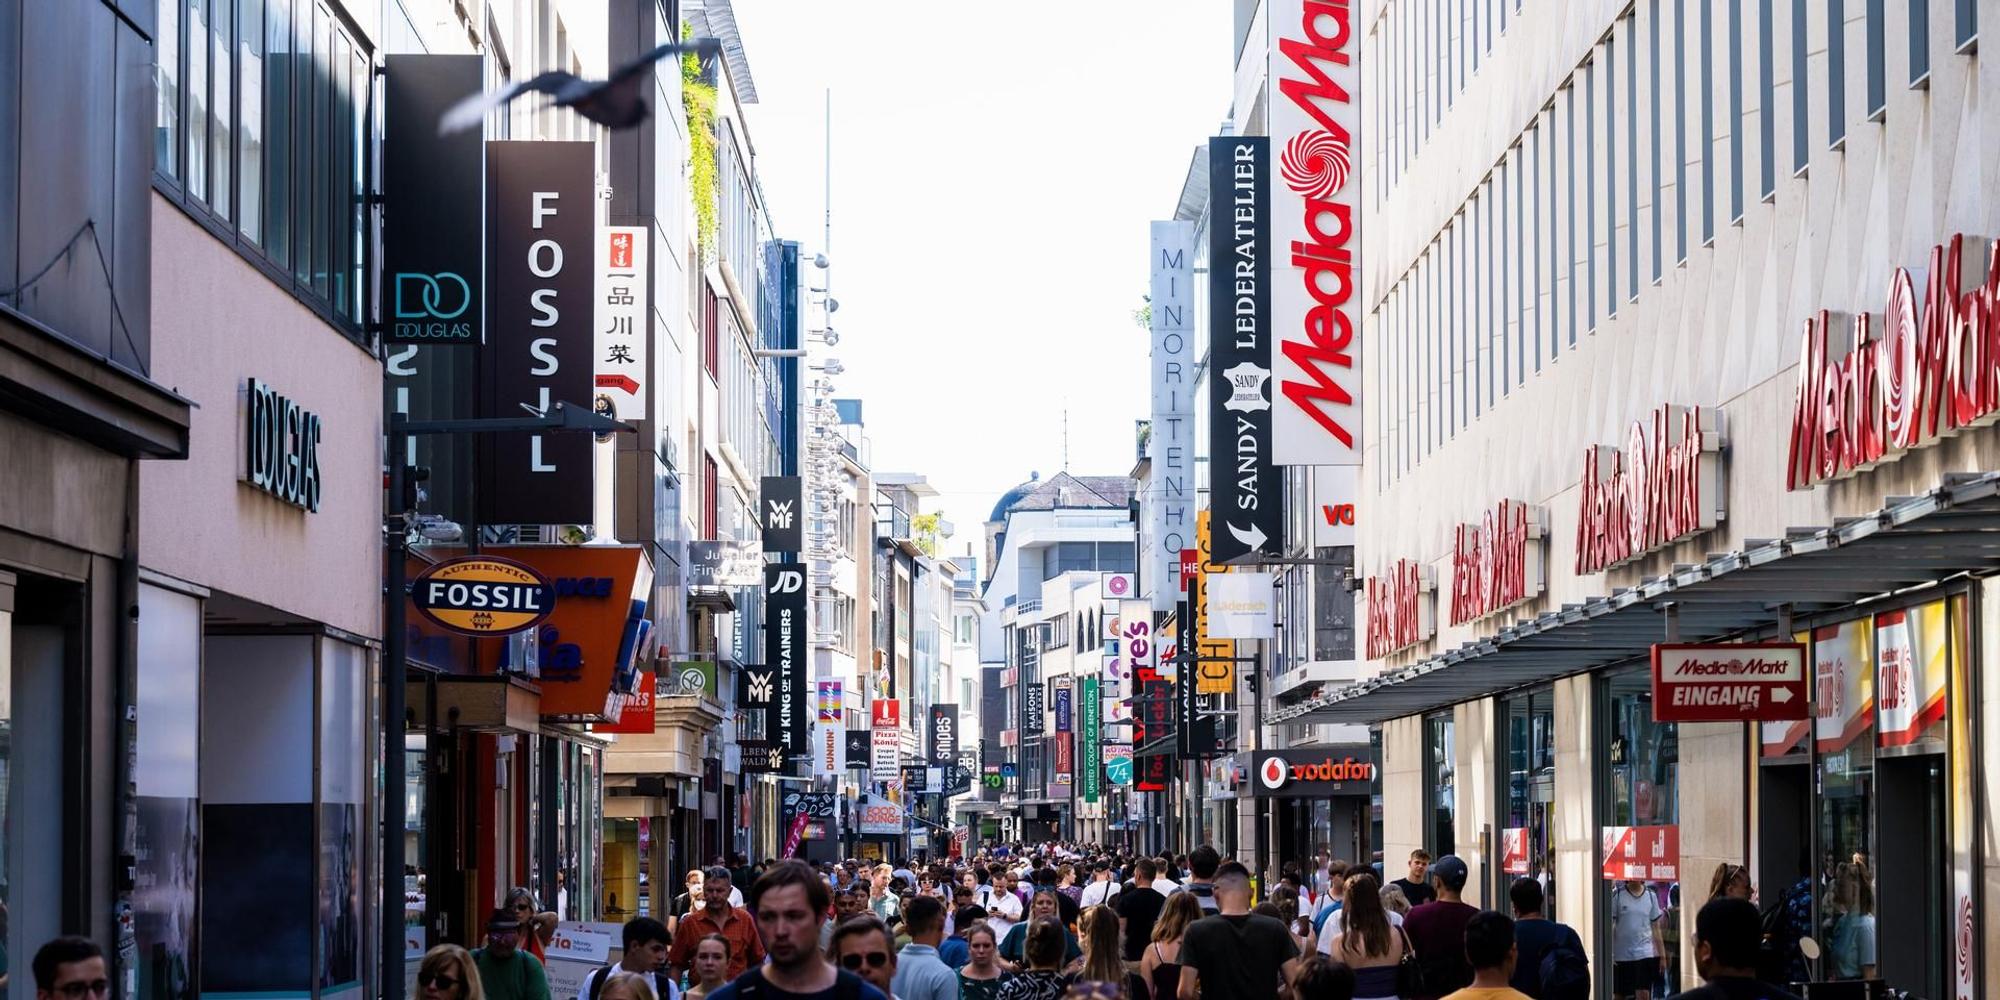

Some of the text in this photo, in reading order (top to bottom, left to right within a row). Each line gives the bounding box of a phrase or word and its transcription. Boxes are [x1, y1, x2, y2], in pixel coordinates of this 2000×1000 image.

[1280, 0, 1350, 148] Ma
[1235, 144, 1257, 349] LEDERATELIER
[395, 323, 470, 337] DOUGLAS
[528, 191, 563, 472] FOSSIL
[605, 273, 635, 364] 一品川菜
[1234, 374, 1260, 388] SANDY
[1162, 248, 1184, 583] MINORITENHOF
[248, 378, 321, 513] DOUGLAS
[1237, 416, 1258, 511] SANDY
[441, 564, 530, 582] AUTHENTIC
[770, 570, 803, 594] JD
[428, 583, 540, 609] FOSSIL
[781, 608, 791, 727] KING OF TRAINERS
[1674, 658, 1788, 675] Media Markt
[1881, 664, 1899, 711] CLUB
[1028, 687, 1036, 730] MAISONS
[1672, 685, 1761, 707] EINGANG
[744, 747, 767, 755] LBEN
[826, 728, 835, 770] DUNKIN'
[874, 739, 898, 747] König
[937, 717, 954, 760] snipes
[1088, 727, 1095, 737] OF
[863, 814, 901, 824] LOUNGE
